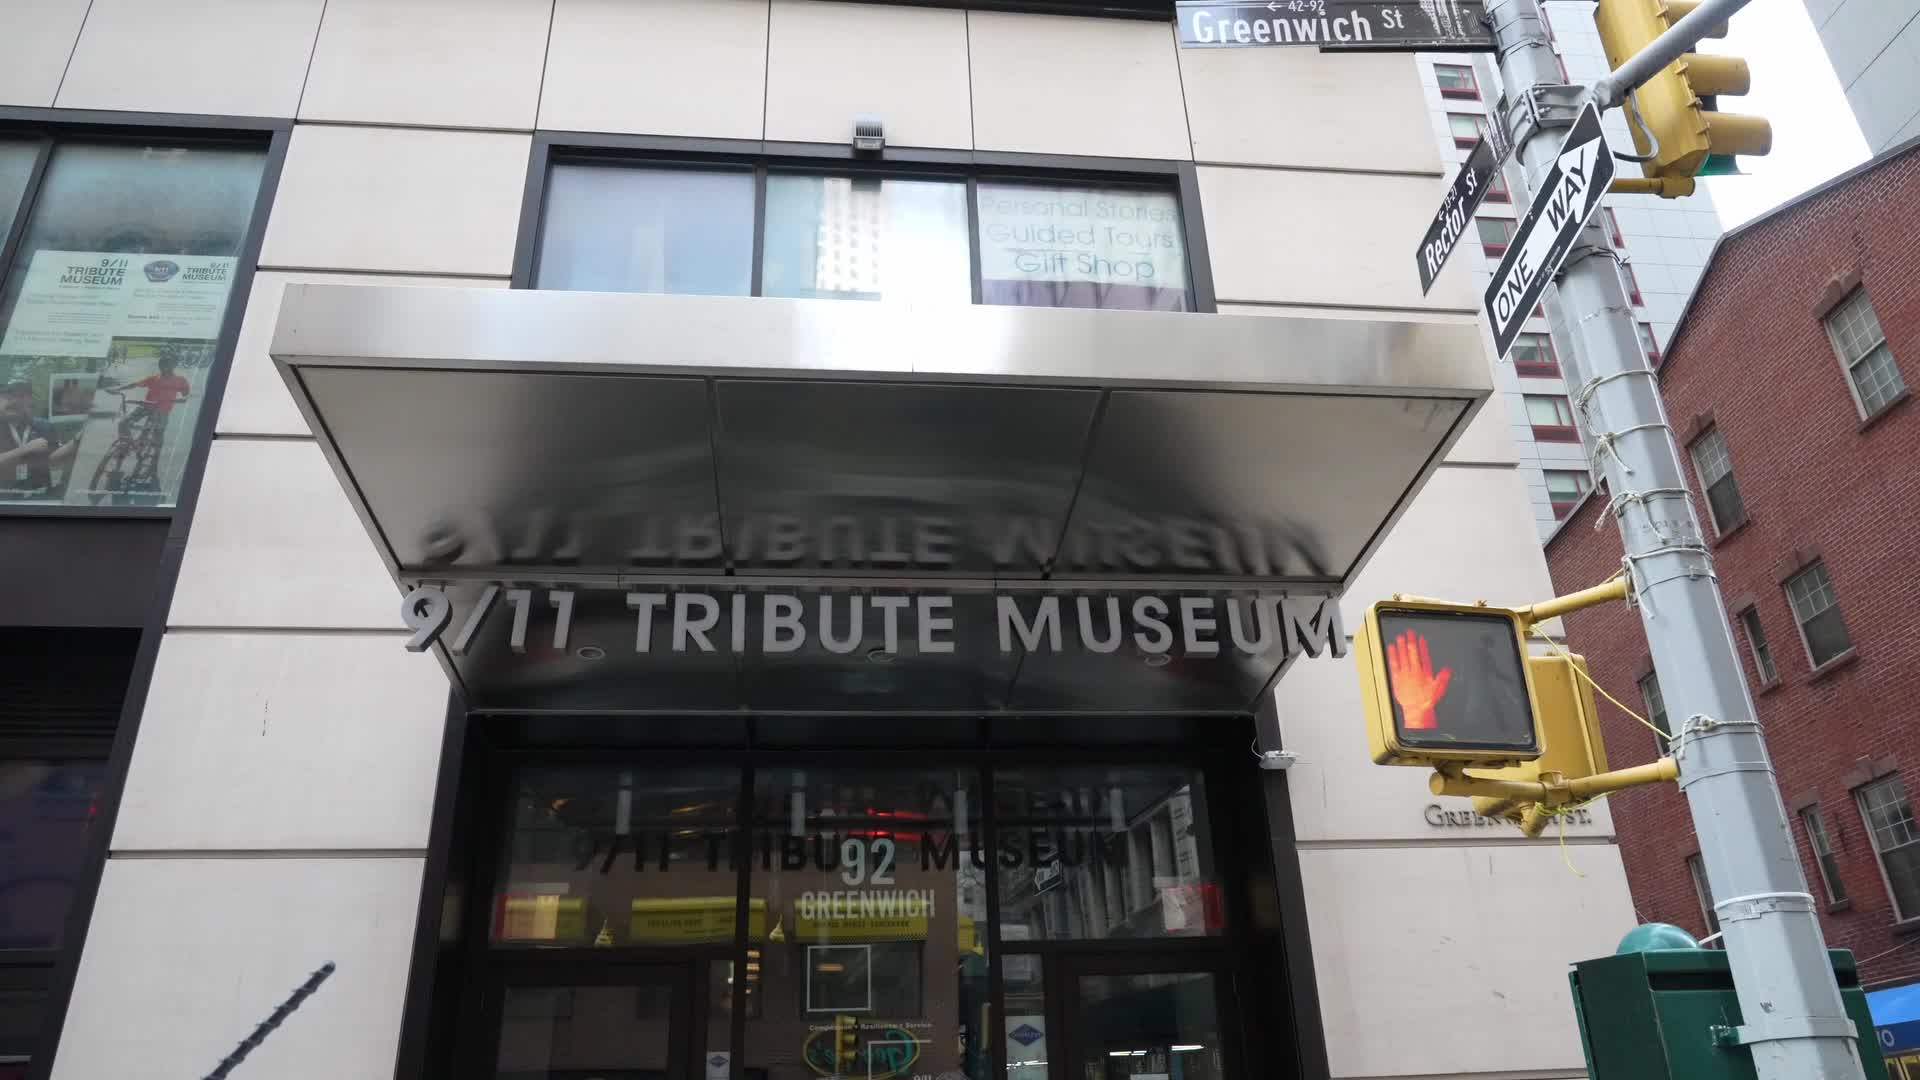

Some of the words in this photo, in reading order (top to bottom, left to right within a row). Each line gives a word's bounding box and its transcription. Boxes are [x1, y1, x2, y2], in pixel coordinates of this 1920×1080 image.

[1288, 0, 1325, 12] 42-92
[1192, 9, 1373, 44] Greenwich
[1381, 9, 1405, 30] St
[1096, 200, 1177, 222] Stories
[987, 224, 1096, 246] Guided
[1103, 226, 1174, 249] Tours
[1424, 196, 1466, 281] Rector
[1466, 167, 1478, 196] St
[1497, 249, 1534, 323] ONE
[1546, 147, 1587, 232] WAY
[67, 266, 127, 277] TRIBUTE
[100, 258, 128, 268] 9/11
[186, 267, 228, 275] TRIBUTE
[1014, 252, 1069, 273] Gift
[1077, 253, 1155, 281] Shop
[59, 275, 123, 286] MUSEUM
[181, 273, 227, 281] MUSEUM
[400, 585, 576, 656] 9/11
[626, 592, 955, 654] TRIBUTE
[996, 595, 1348, 660] MUSEUM
[840, 837, 896, 887] 92
[801, 888, 936, 921] GREENWICH
